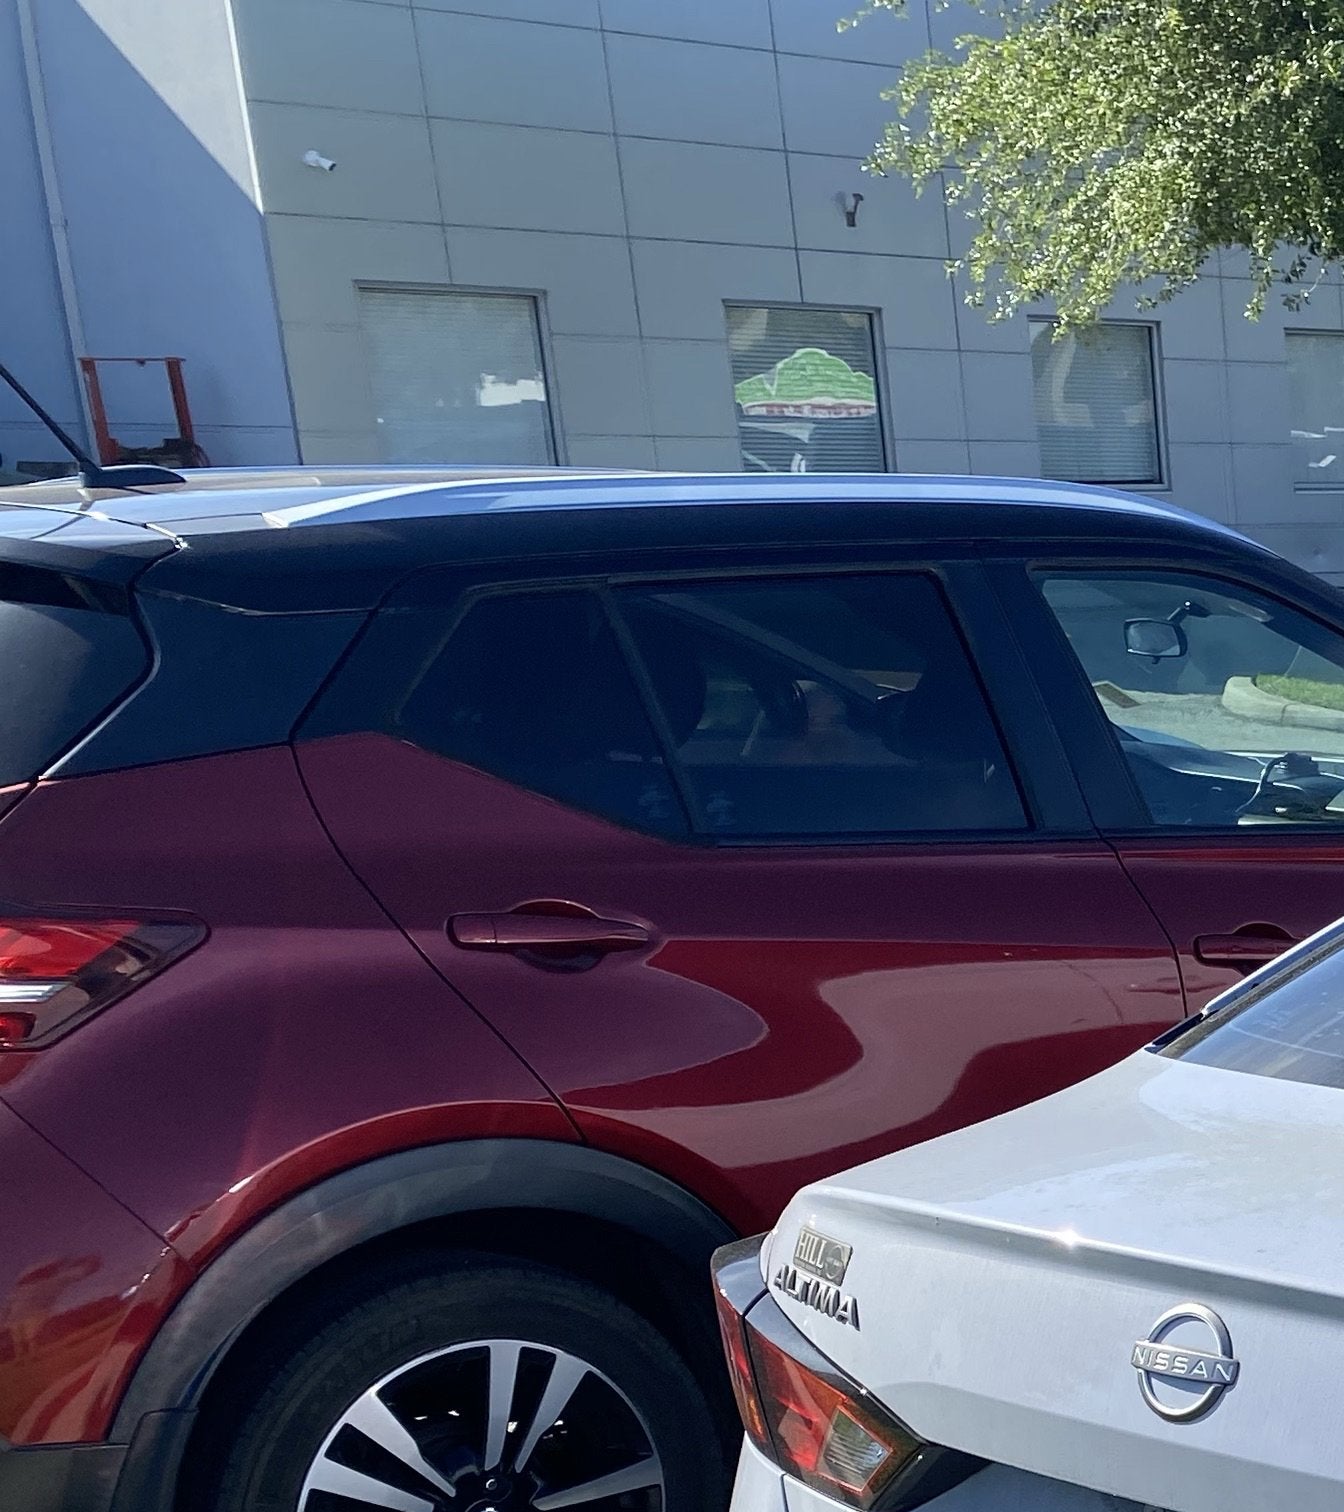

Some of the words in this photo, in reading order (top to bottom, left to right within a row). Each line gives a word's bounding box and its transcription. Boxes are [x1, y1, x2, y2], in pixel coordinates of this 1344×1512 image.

[795, 1231, 827, 1269] HILL
[774, 1264, 860, 1332] ALTIMA
[1132, 1345, 1234, 1382] NISSAN
